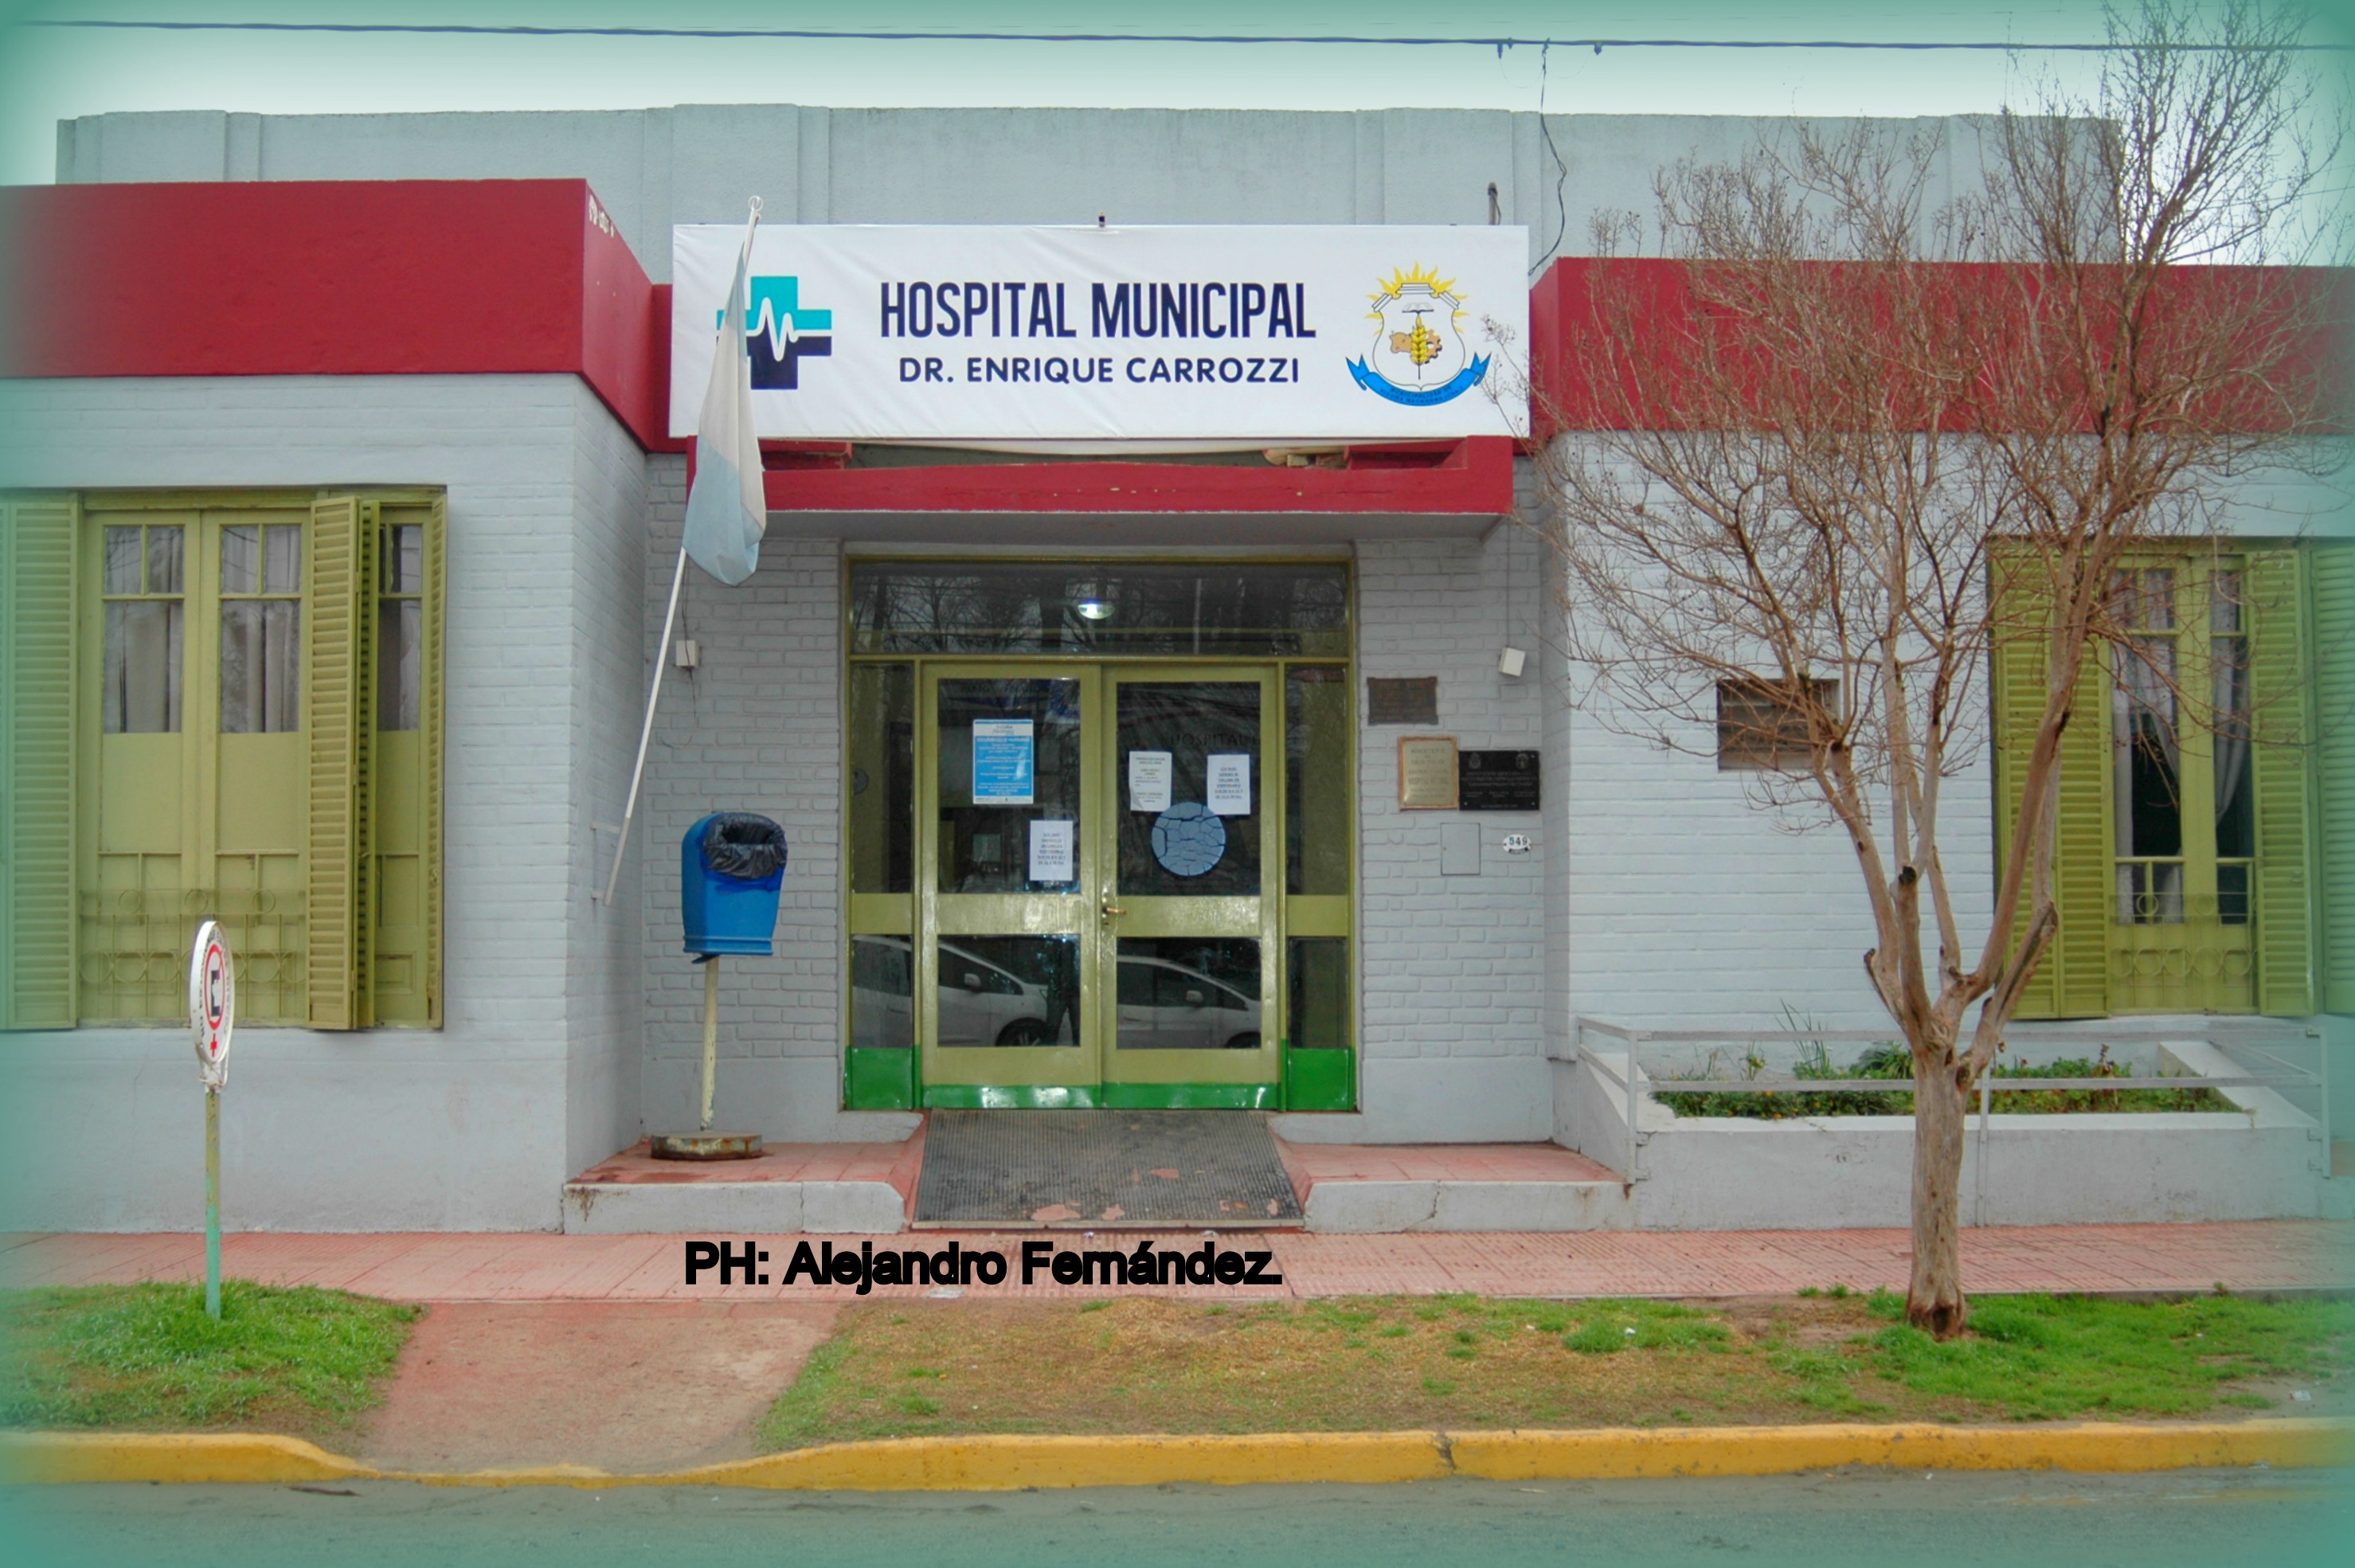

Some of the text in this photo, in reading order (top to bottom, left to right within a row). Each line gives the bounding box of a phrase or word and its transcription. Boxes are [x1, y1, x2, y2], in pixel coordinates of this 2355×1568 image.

[882, 282, 1316, 338] HOSPITAL MUNICIPAL
[901, 358, 1297, 384] DR. ENRIQUE CARROZZI
[1508, 836, 1528, 847] 549
